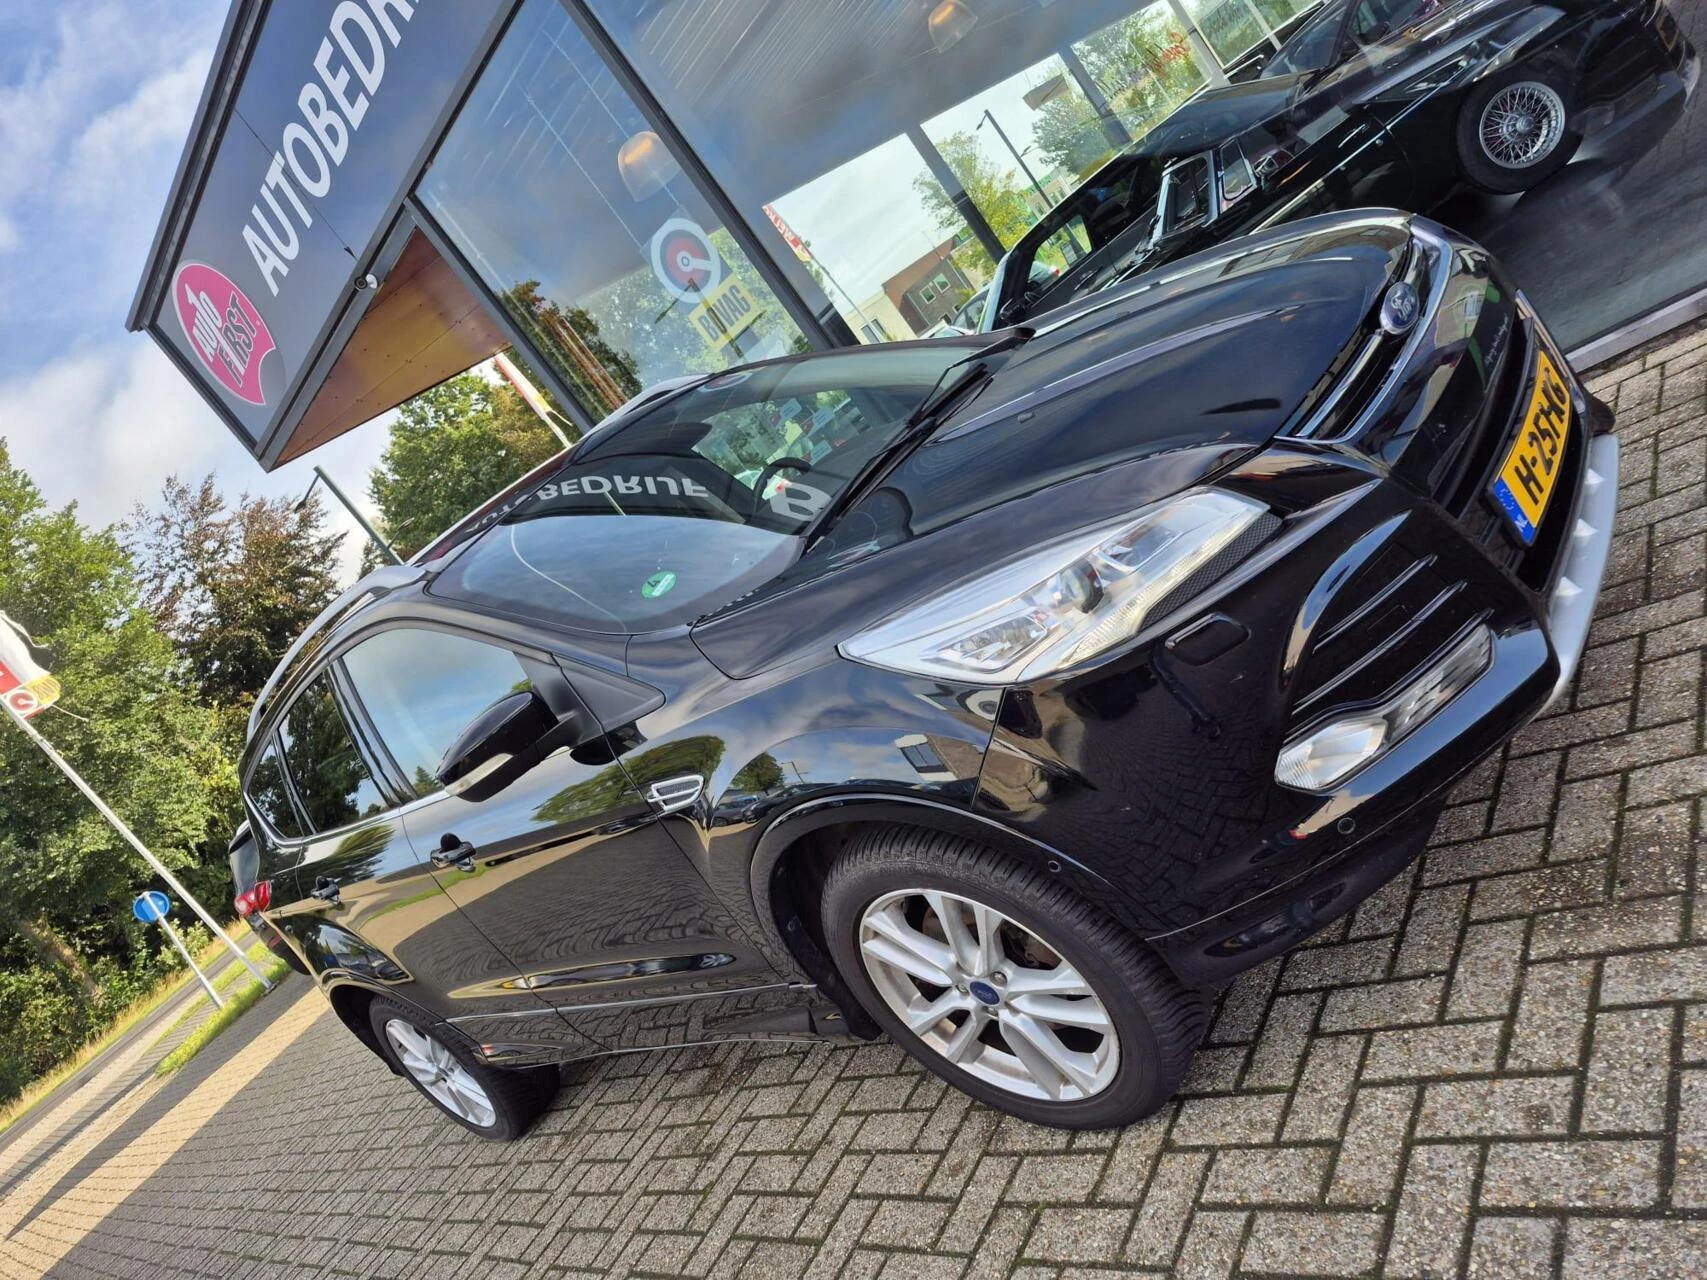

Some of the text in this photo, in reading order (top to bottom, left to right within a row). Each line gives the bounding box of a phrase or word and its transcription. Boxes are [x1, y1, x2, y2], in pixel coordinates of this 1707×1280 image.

[242, 0, 418, 296] AUTOBED
[185, 283, 222, 363] AUTO
[217, 290, 257, 388] FIRST
